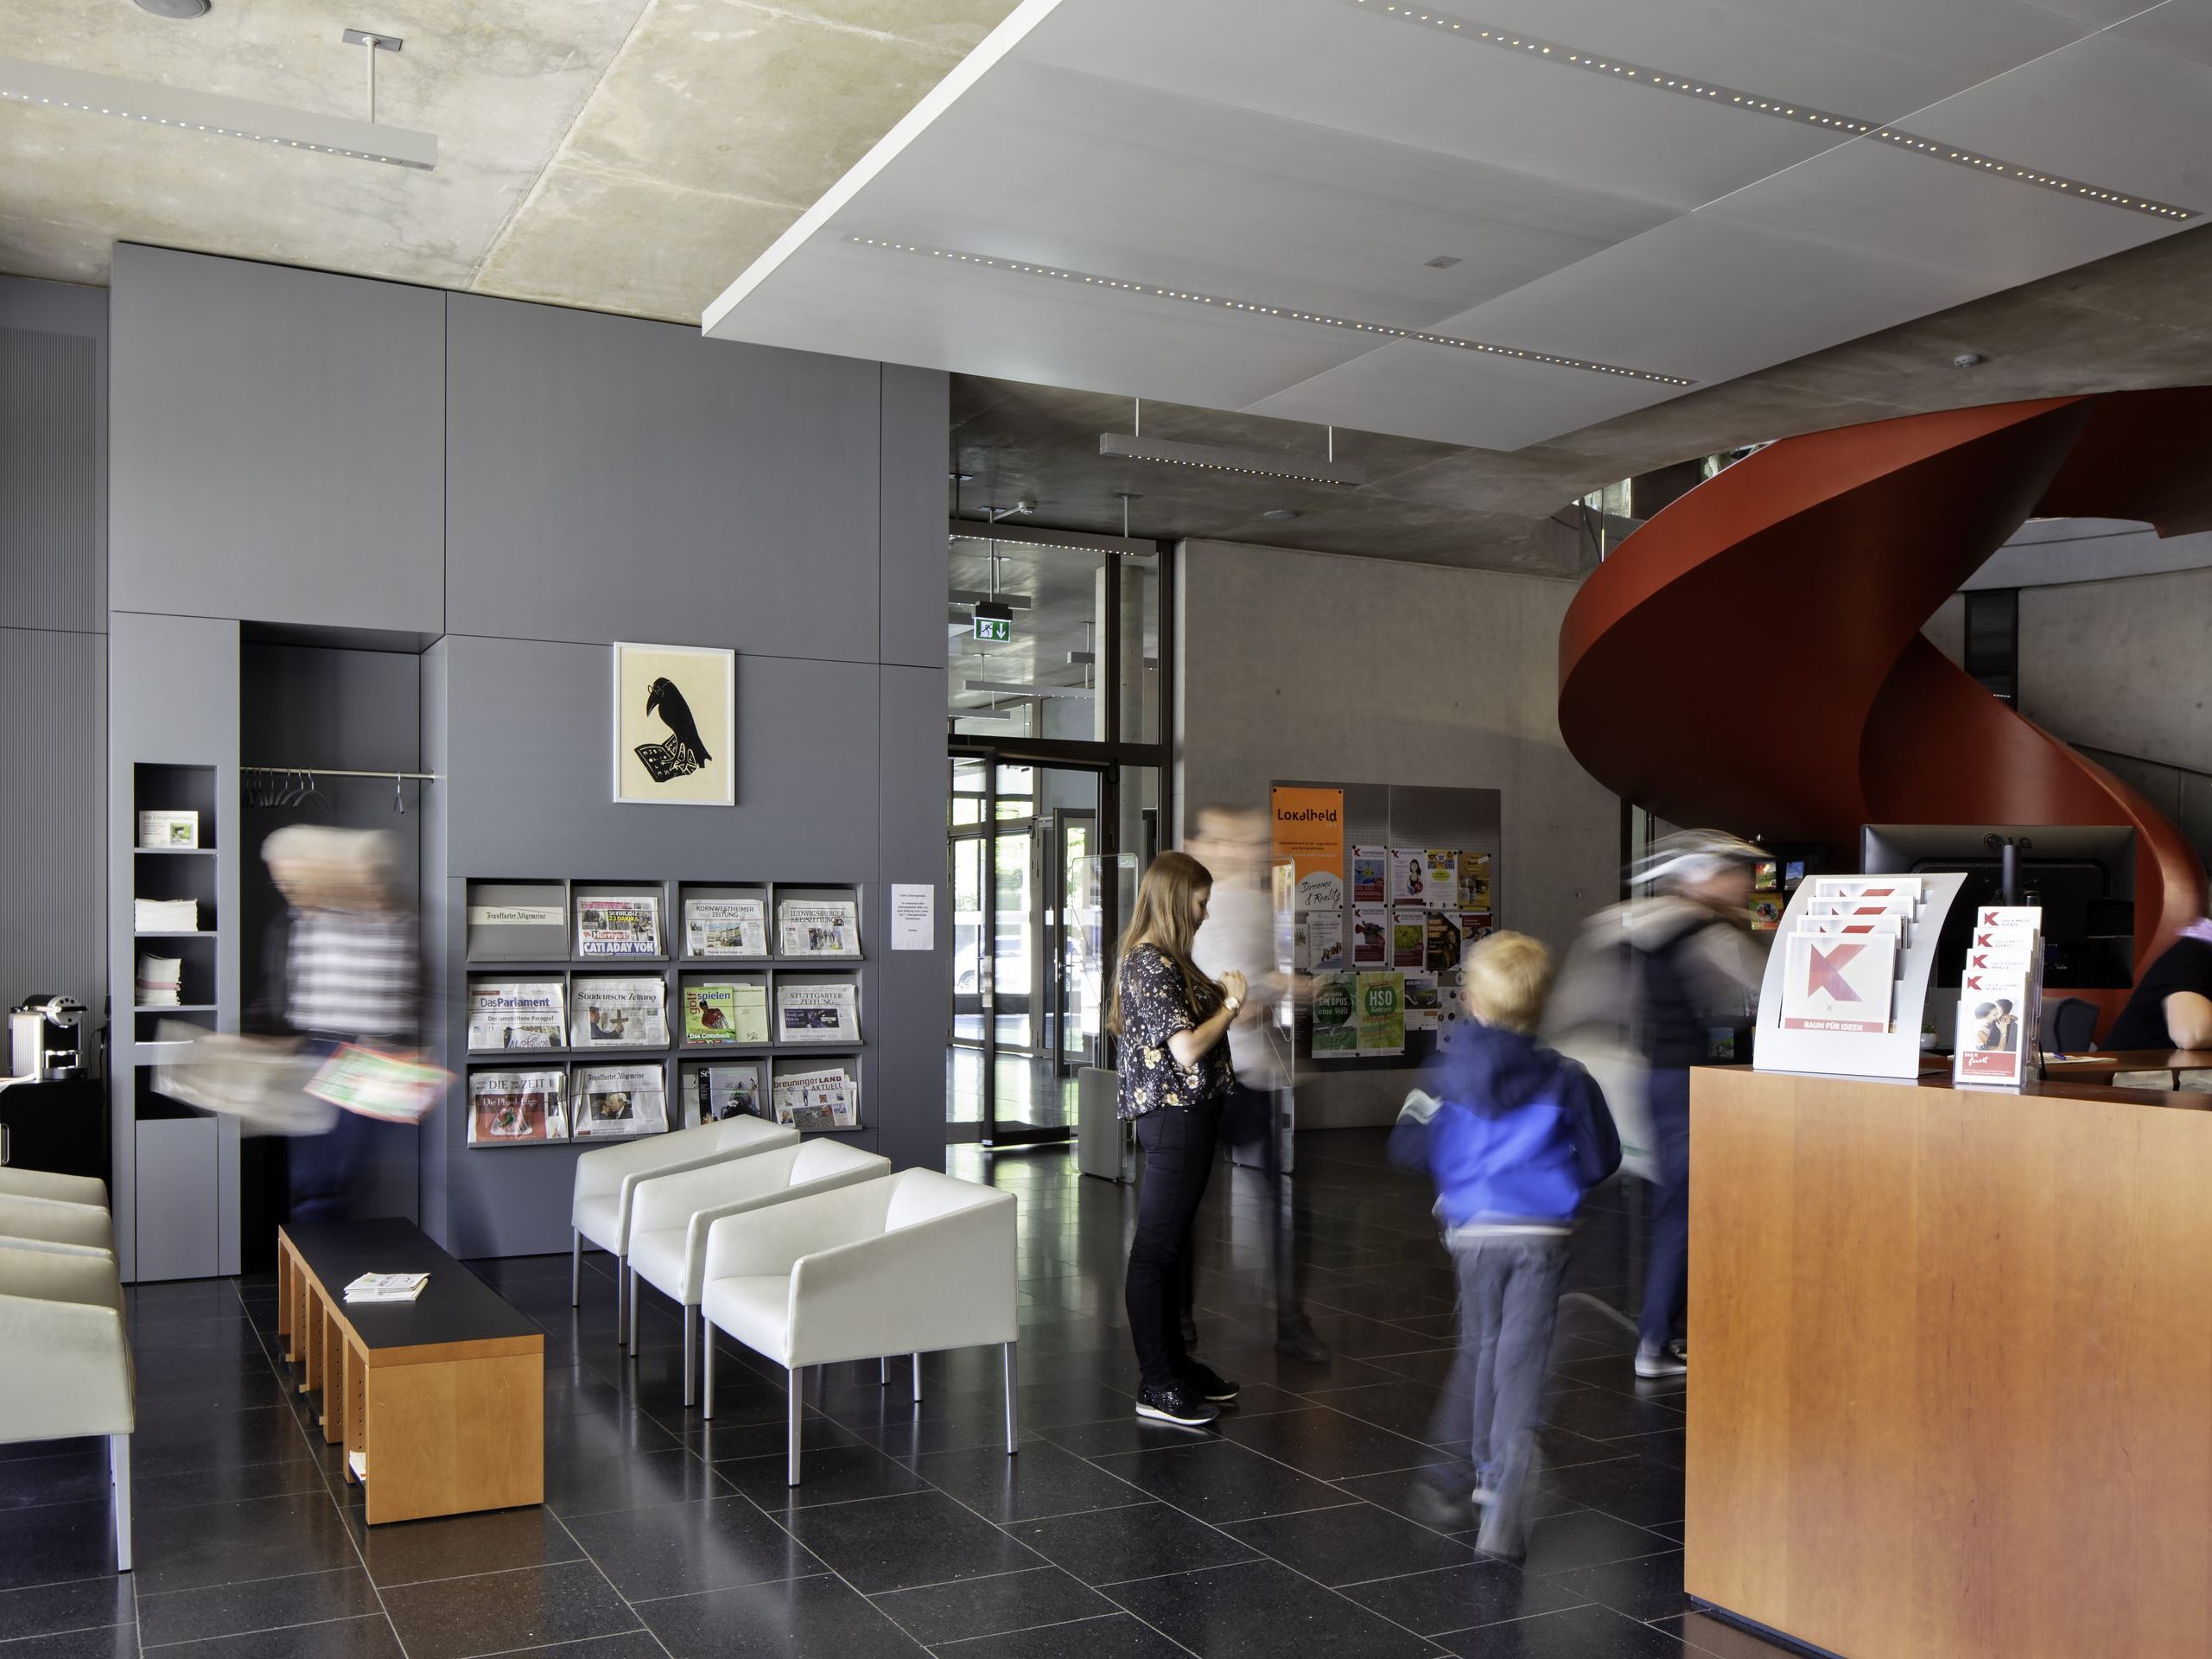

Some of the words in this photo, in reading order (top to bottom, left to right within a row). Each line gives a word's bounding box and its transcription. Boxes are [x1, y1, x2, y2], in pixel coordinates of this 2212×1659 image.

[1277, 809, 1338, 822] Lokalheld
[486, 912, 517, 920] Frankfurter
[517, 912, 546, 920] Allgemeine
[607, 942, 632, 953] ADAY
[633, 942, 654, 953] YOK
[578, 991, 627, 1001] Süddeutsche
[628, 992, 657, 1002] Zeitung
[697, 991, 731, 1002] spielen
[1370, 990, 1392, 1006] HSO
[687, 991, 700, 1015] golf
[1803, 1020, 1825, 1029] RAUM
[1825, 1021, 1840, 1030] FÜR
[1840, 1023, 1864, 1032] IDEEN
[489, 1080, 507, 1089] DIE
[521, 1078, 544, 1089] ZEIT
[811, 1083, 842, 1091] AKTUELL
